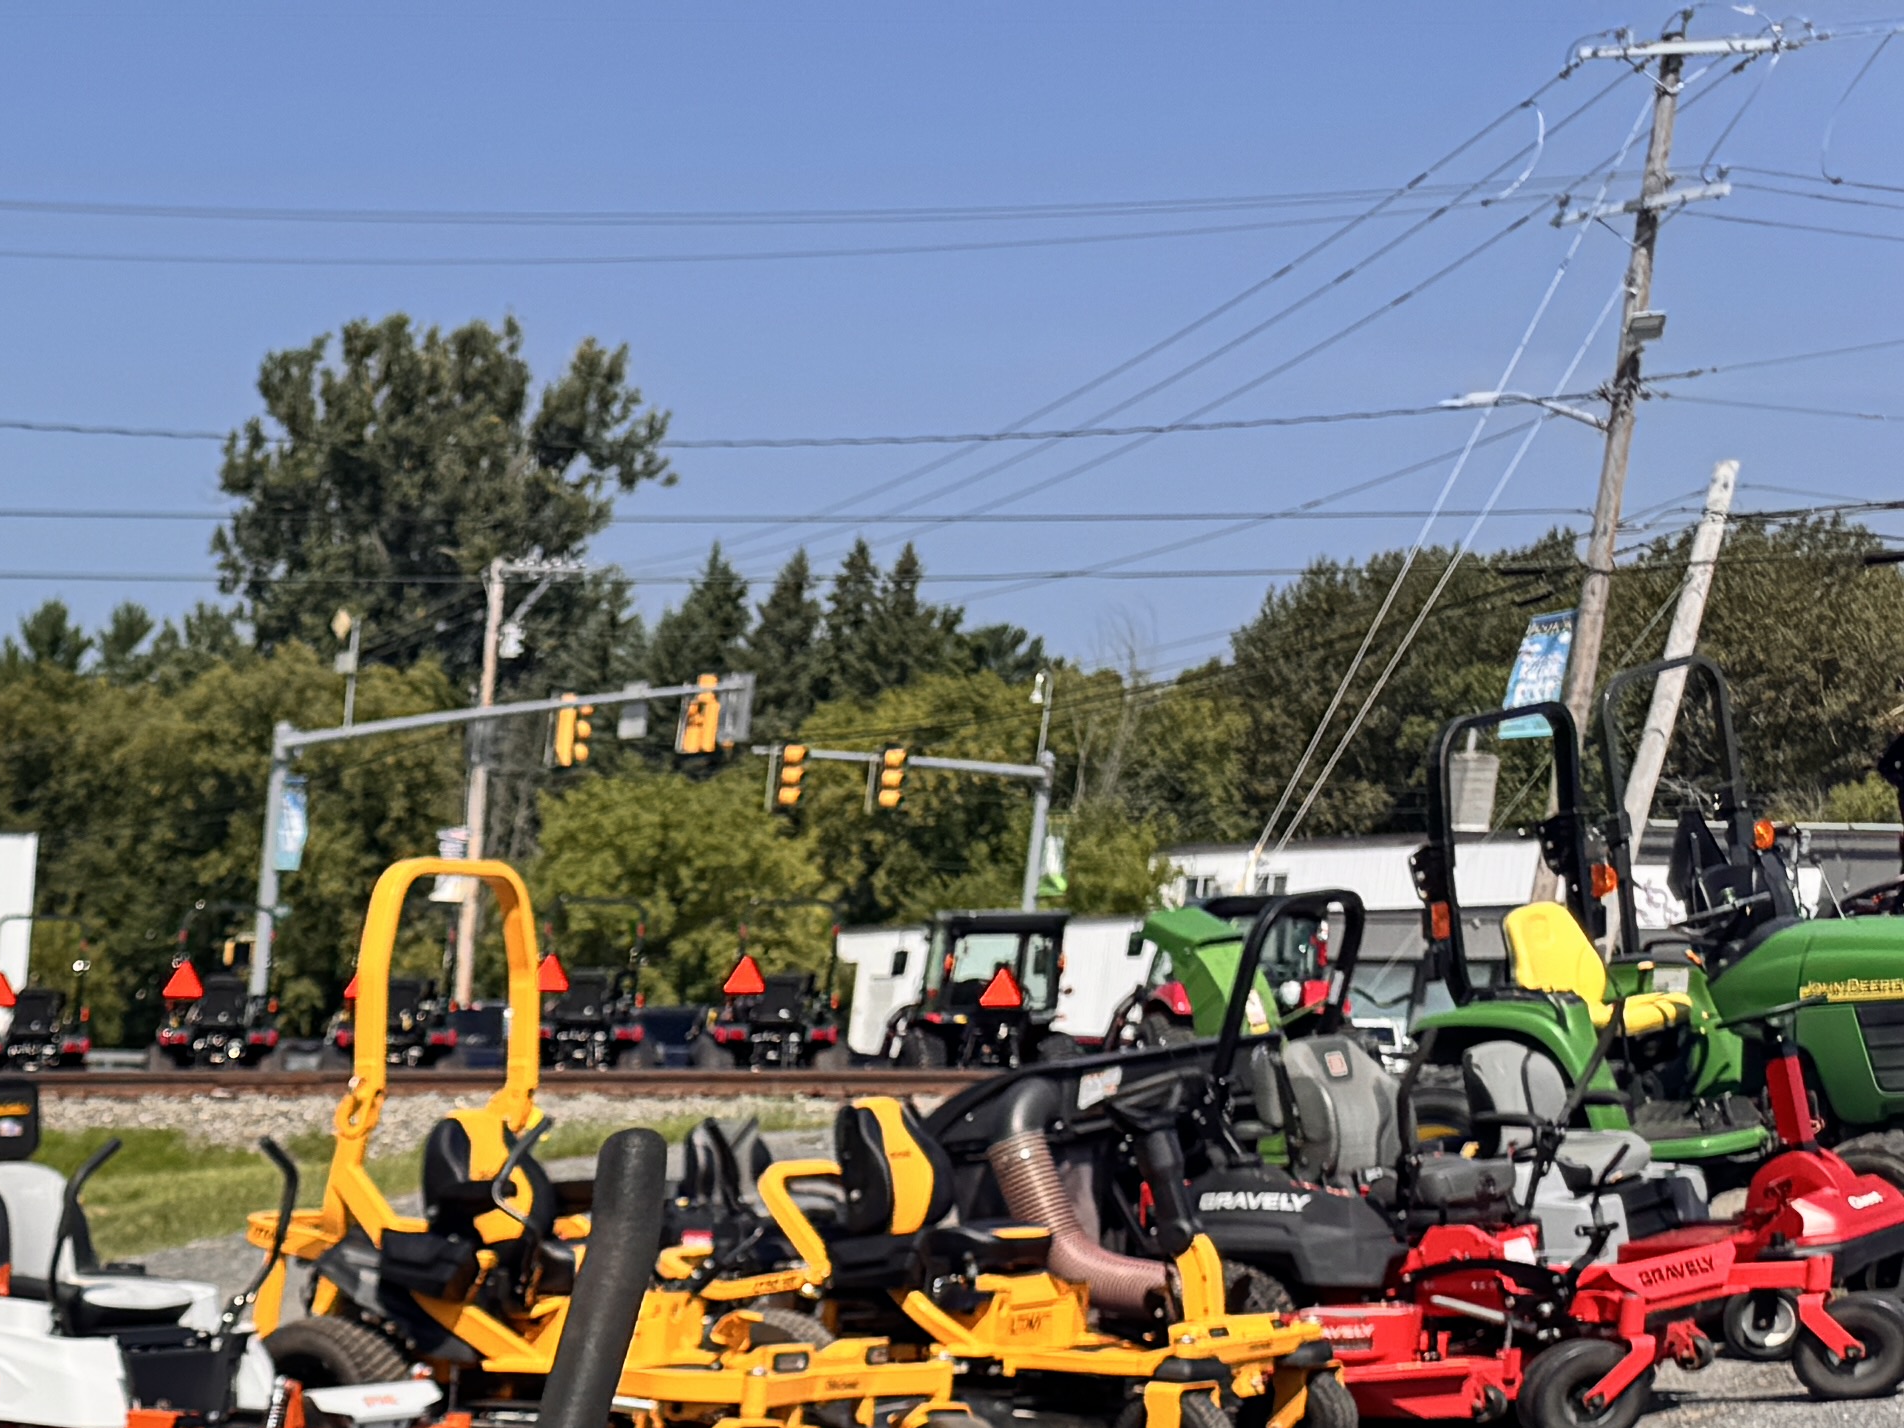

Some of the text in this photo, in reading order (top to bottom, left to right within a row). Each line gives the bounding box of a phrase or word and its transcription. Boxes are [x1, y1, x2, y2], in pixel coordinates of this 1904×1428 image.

[1198, 1191, 1312, 1213] GRAVELY
[1638, 1254, 1715, 1287] GRAVELY
[1322, 1323, 1375, 1339] AVELY
